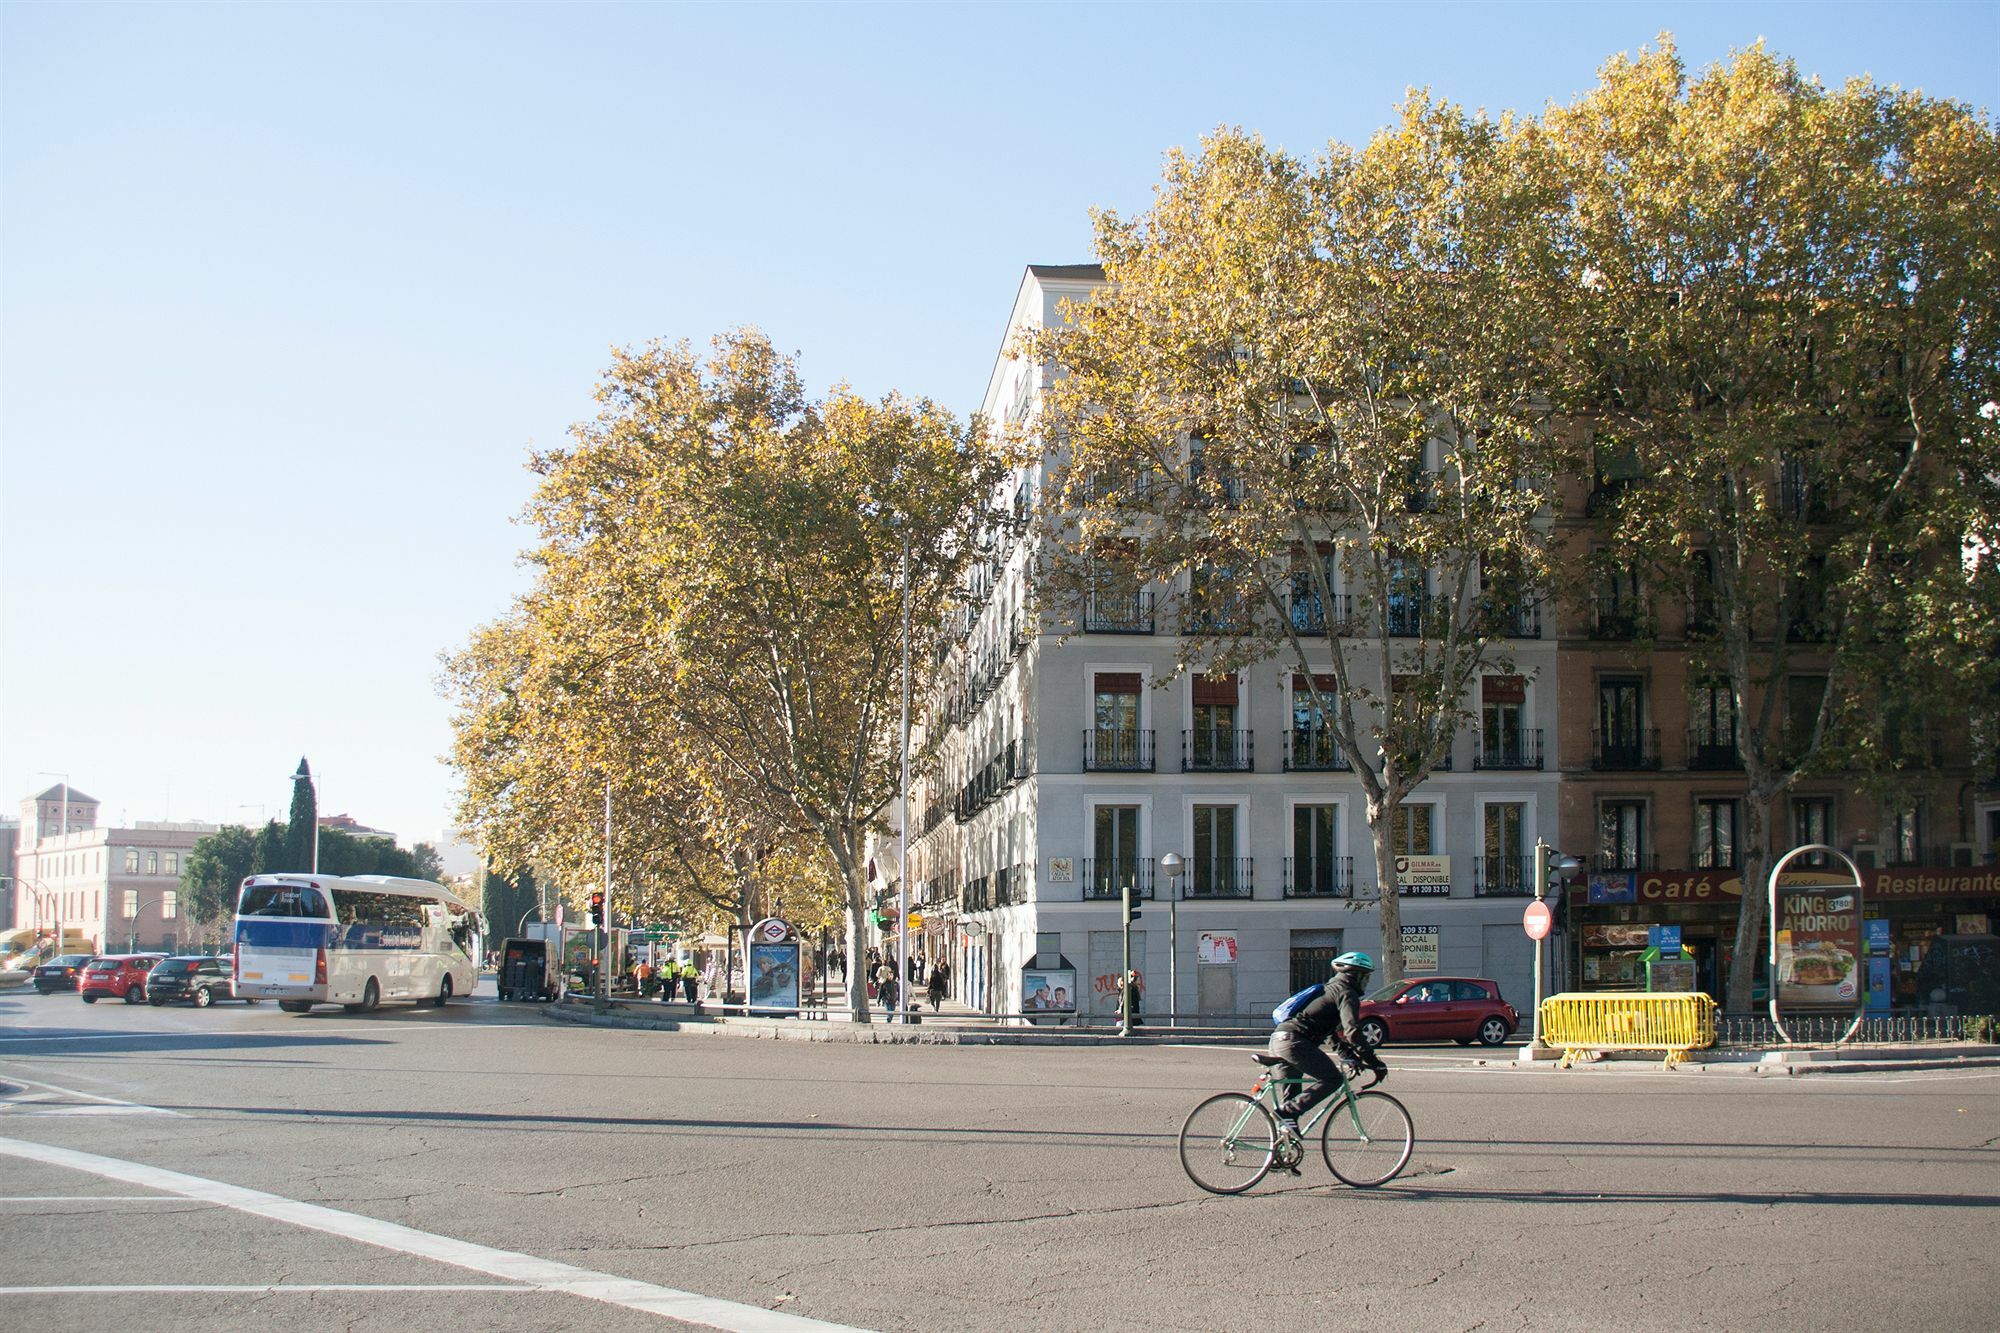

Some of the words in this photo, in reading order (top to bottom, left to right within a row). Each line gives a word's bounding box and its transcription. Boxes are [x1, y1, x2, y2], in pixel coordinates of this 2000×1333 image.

[1413, 875, 1449, 884] DISPONIBLE
[1643, 877, 1711, 898] Café
[1402, 926, 1416, 934] 209
[1417, 926, 1427, 934] 32
[1428, 926, 1437, 934] 50
[1783, 915, 1849, 932] AHORRO
